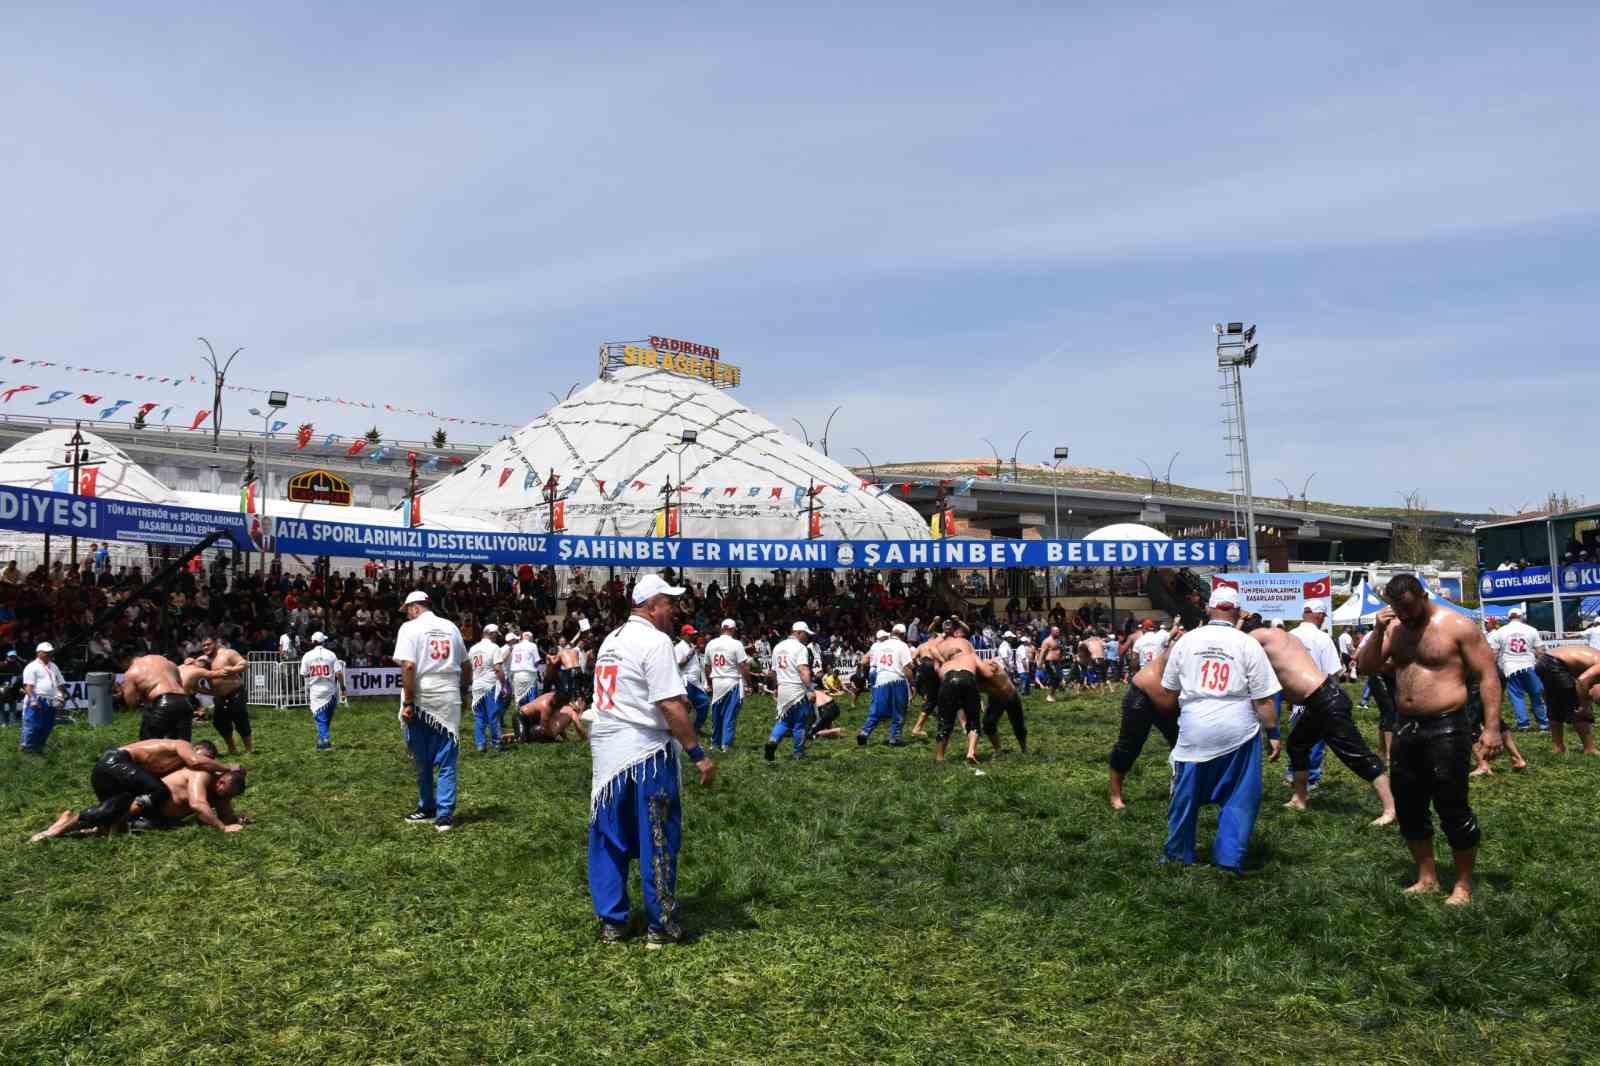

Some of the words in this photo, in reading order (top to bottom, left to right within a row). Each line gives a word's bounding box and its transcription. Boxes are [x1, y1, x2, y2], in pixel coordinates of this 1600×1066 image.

[107, 504, 124, 515] TÜM
[126, 507, 168, 520] ANTRENÖR
[181, 511, 244, 526] SPORCULARIMIZA
[139, 520, 183, 533] BAŞARILAR
[277, 520, 308, 539] ATA
[312, 524, 422, 547] SPORLARIMIZI
[559, 539, 680, 561] ŞAHİNBEY
[692, 543, 720, 561] ER
[729, 543, 827, 561] MEYDANI
[864, 543, 1027, 566] ŞAHİNBEY
[1047, 542, 1215, 562] BELEDİYESİ
[1495, 576, 1521, 588] CETVEL
[1510, 638, 1527, 653] 52
[880, 655, 893, 667] 43
[351, 671, 381, 689] TÜM
[1201, 660, 1230, 691] 139
[595, 665, 618, 711] 17
